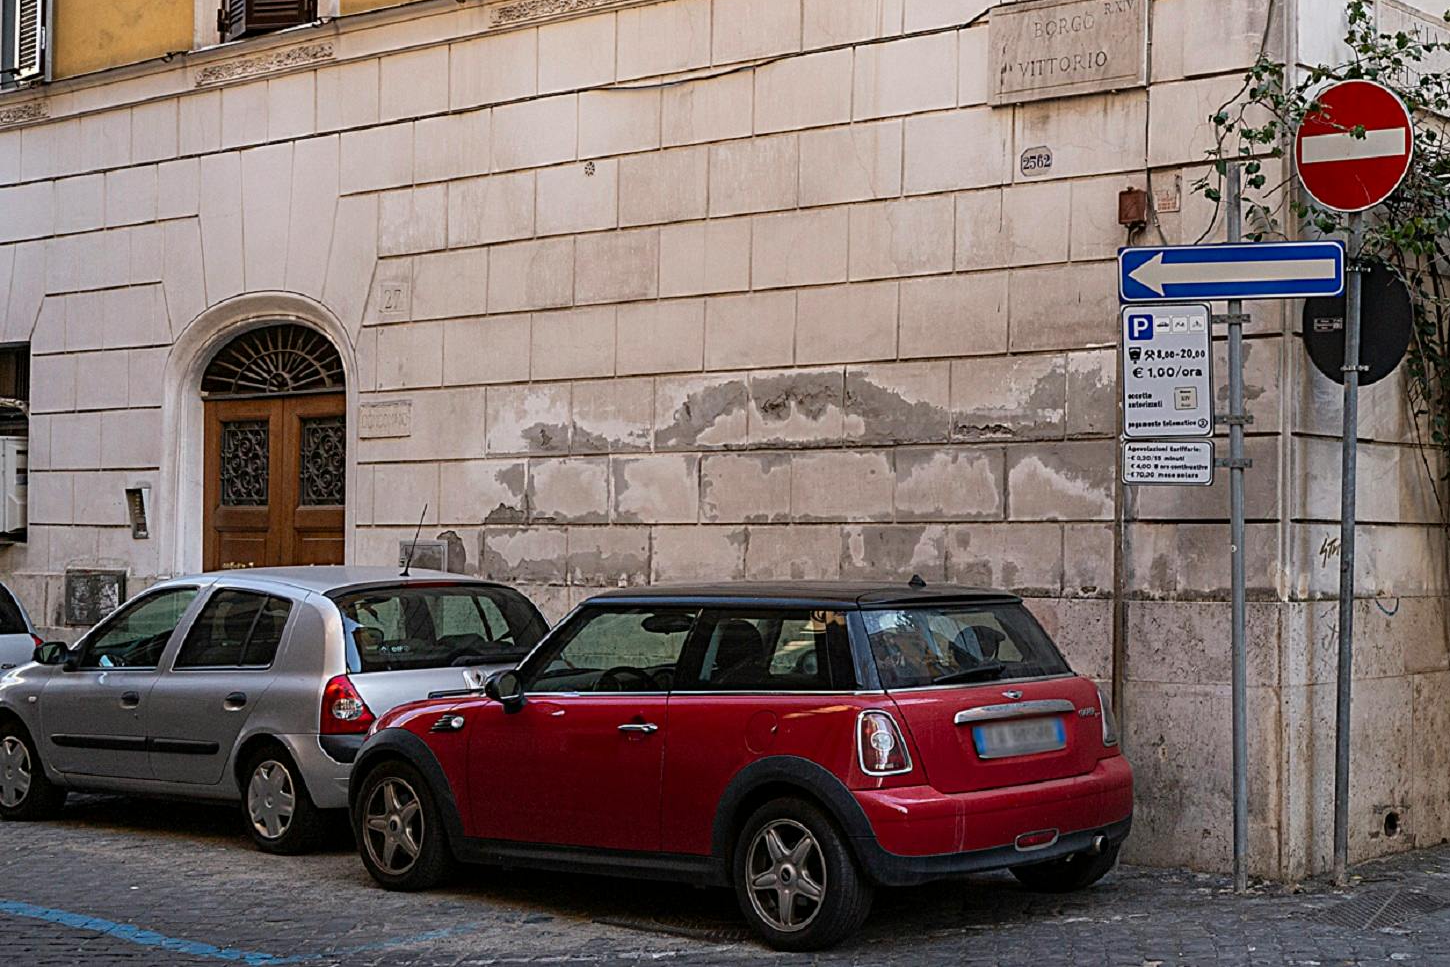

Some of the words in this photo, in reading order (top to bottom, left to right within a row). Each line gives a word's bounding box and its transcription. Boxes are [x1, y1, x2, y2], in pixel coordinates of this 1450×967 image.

[1034, 12, 1095, 38] BORGO
[1018, 50, 1108, 78] VITTORIO
[1022, 153, 1051, 170] 2562
[384, 289, 401, 309] 27
[1132, 317, 1149, 338] P
